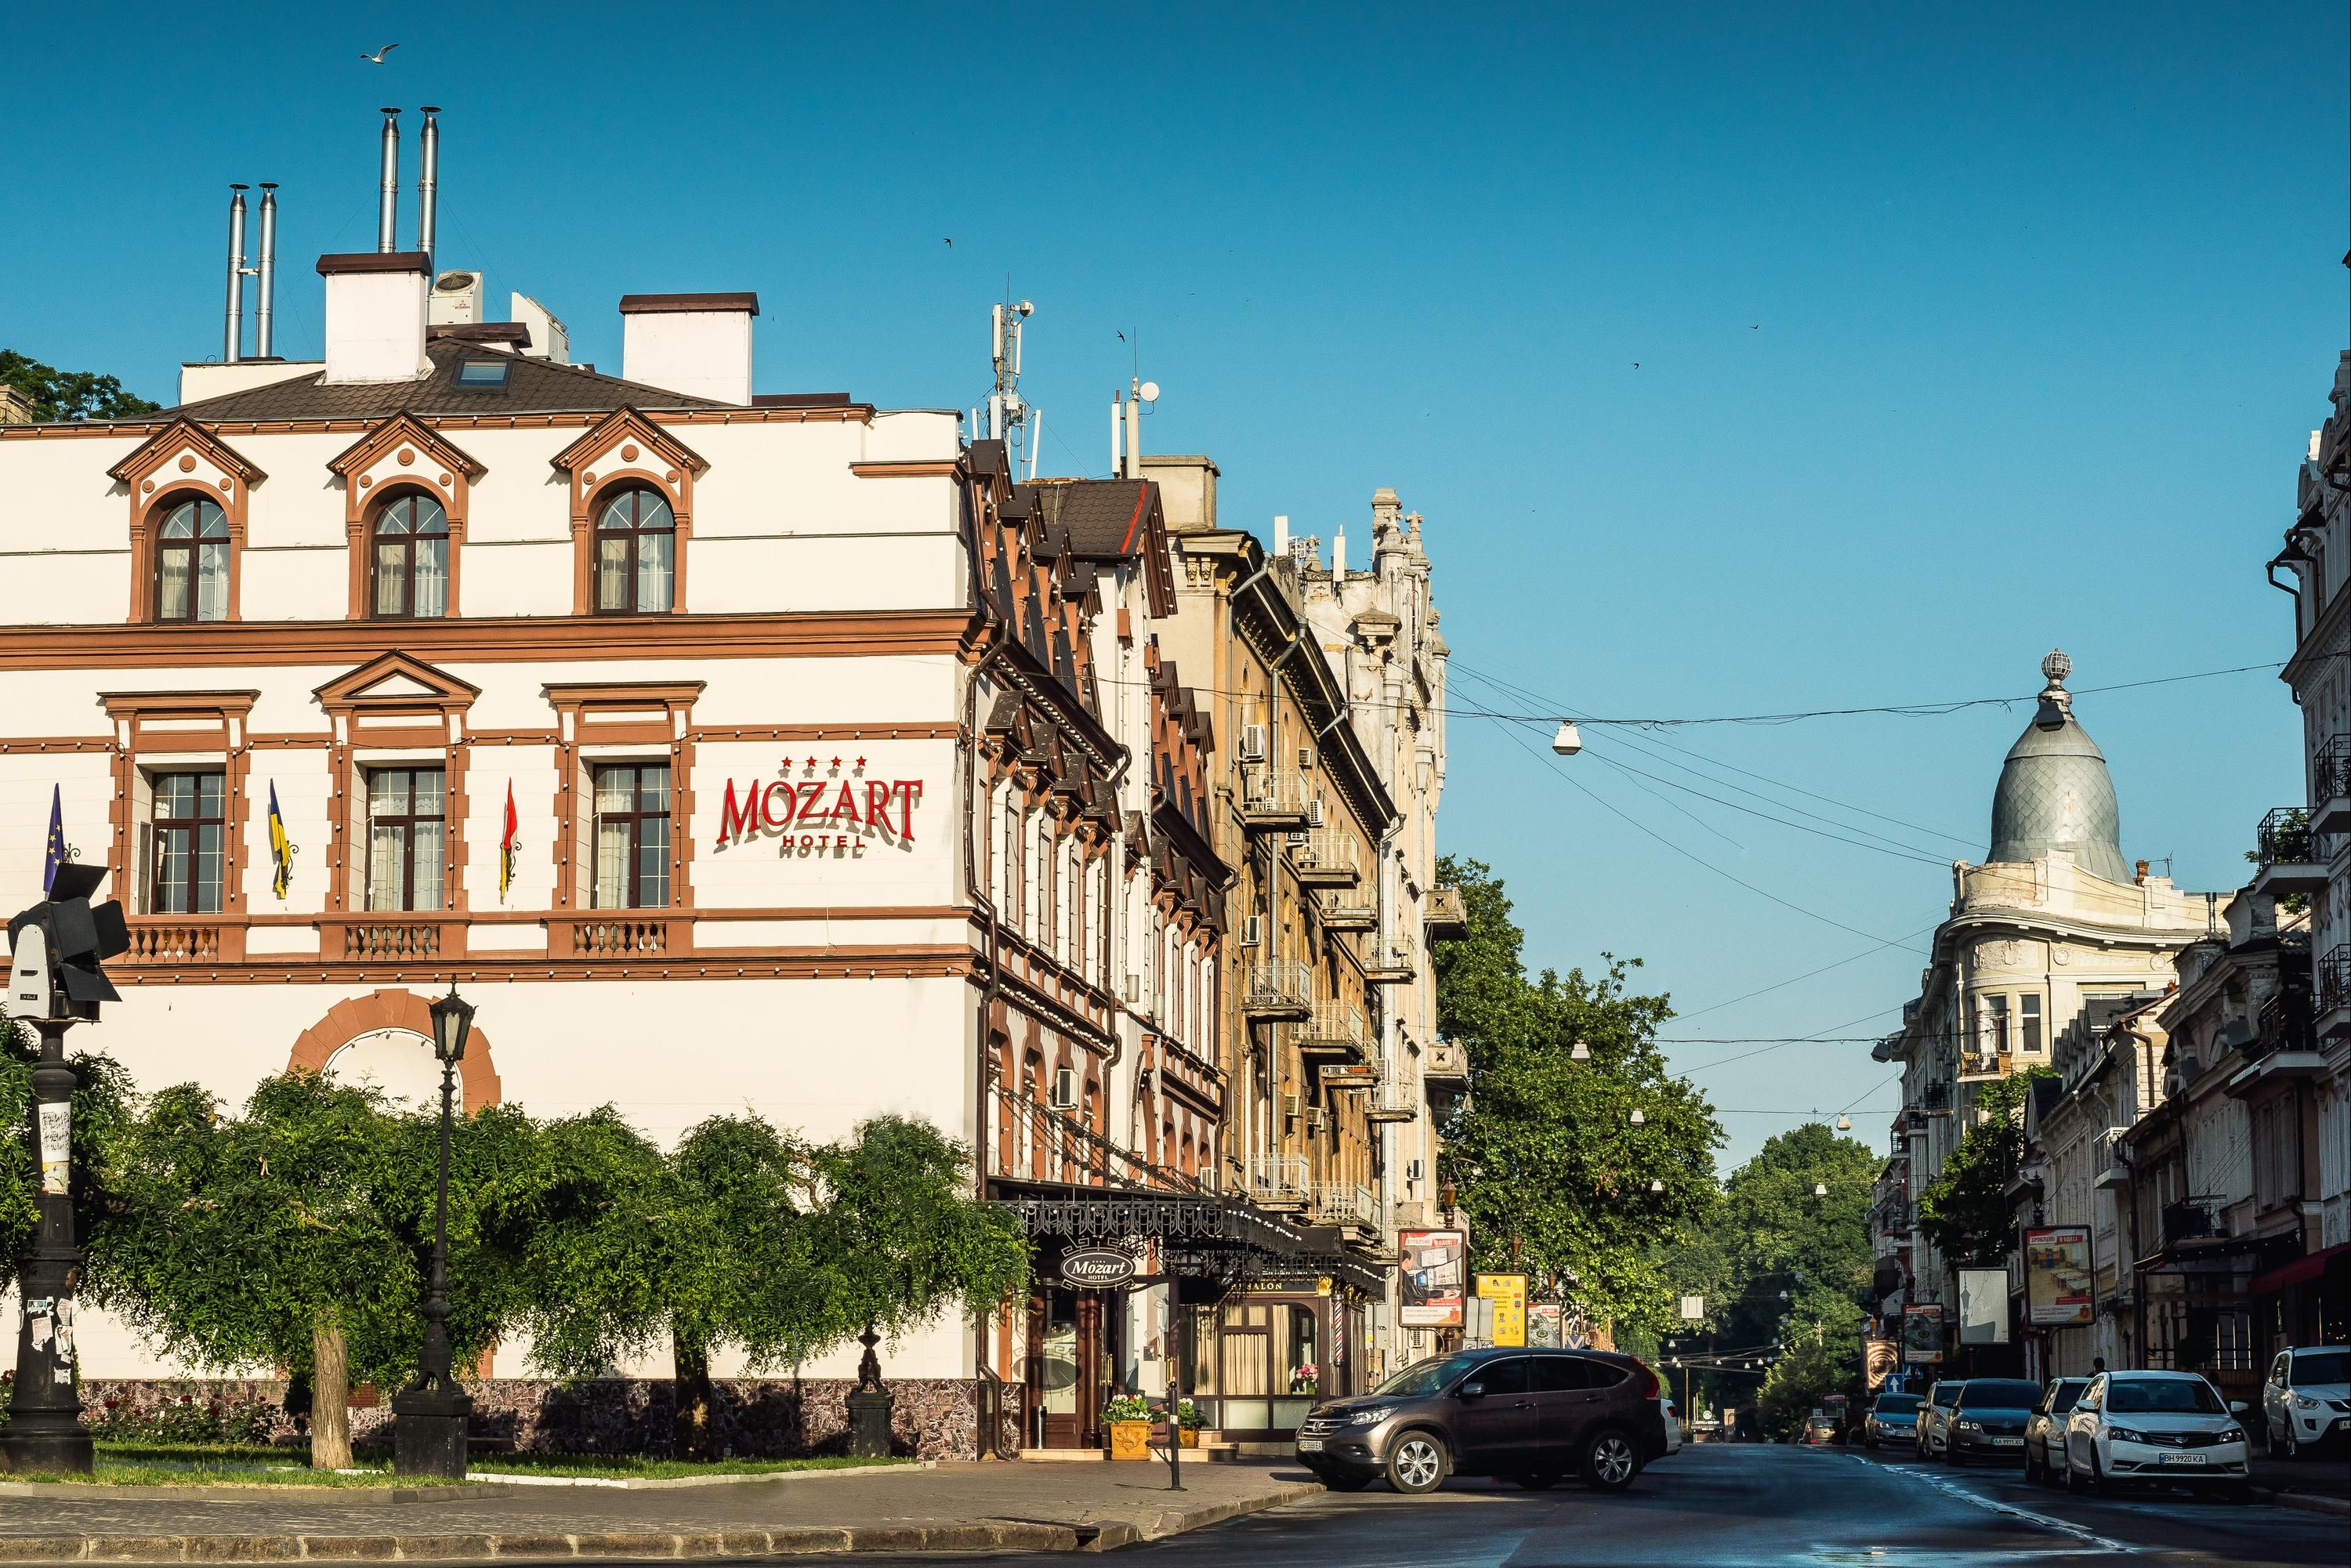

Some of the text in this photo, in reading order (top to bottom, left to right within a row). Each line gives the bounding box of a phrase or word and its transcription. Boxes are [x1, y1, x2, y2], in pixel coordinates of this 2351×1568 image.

[716, 777, 923, 844] MOZART
[783, 835, 866, 848] HOTEL
[1070, 1261, 1125, 1274] Mozart
